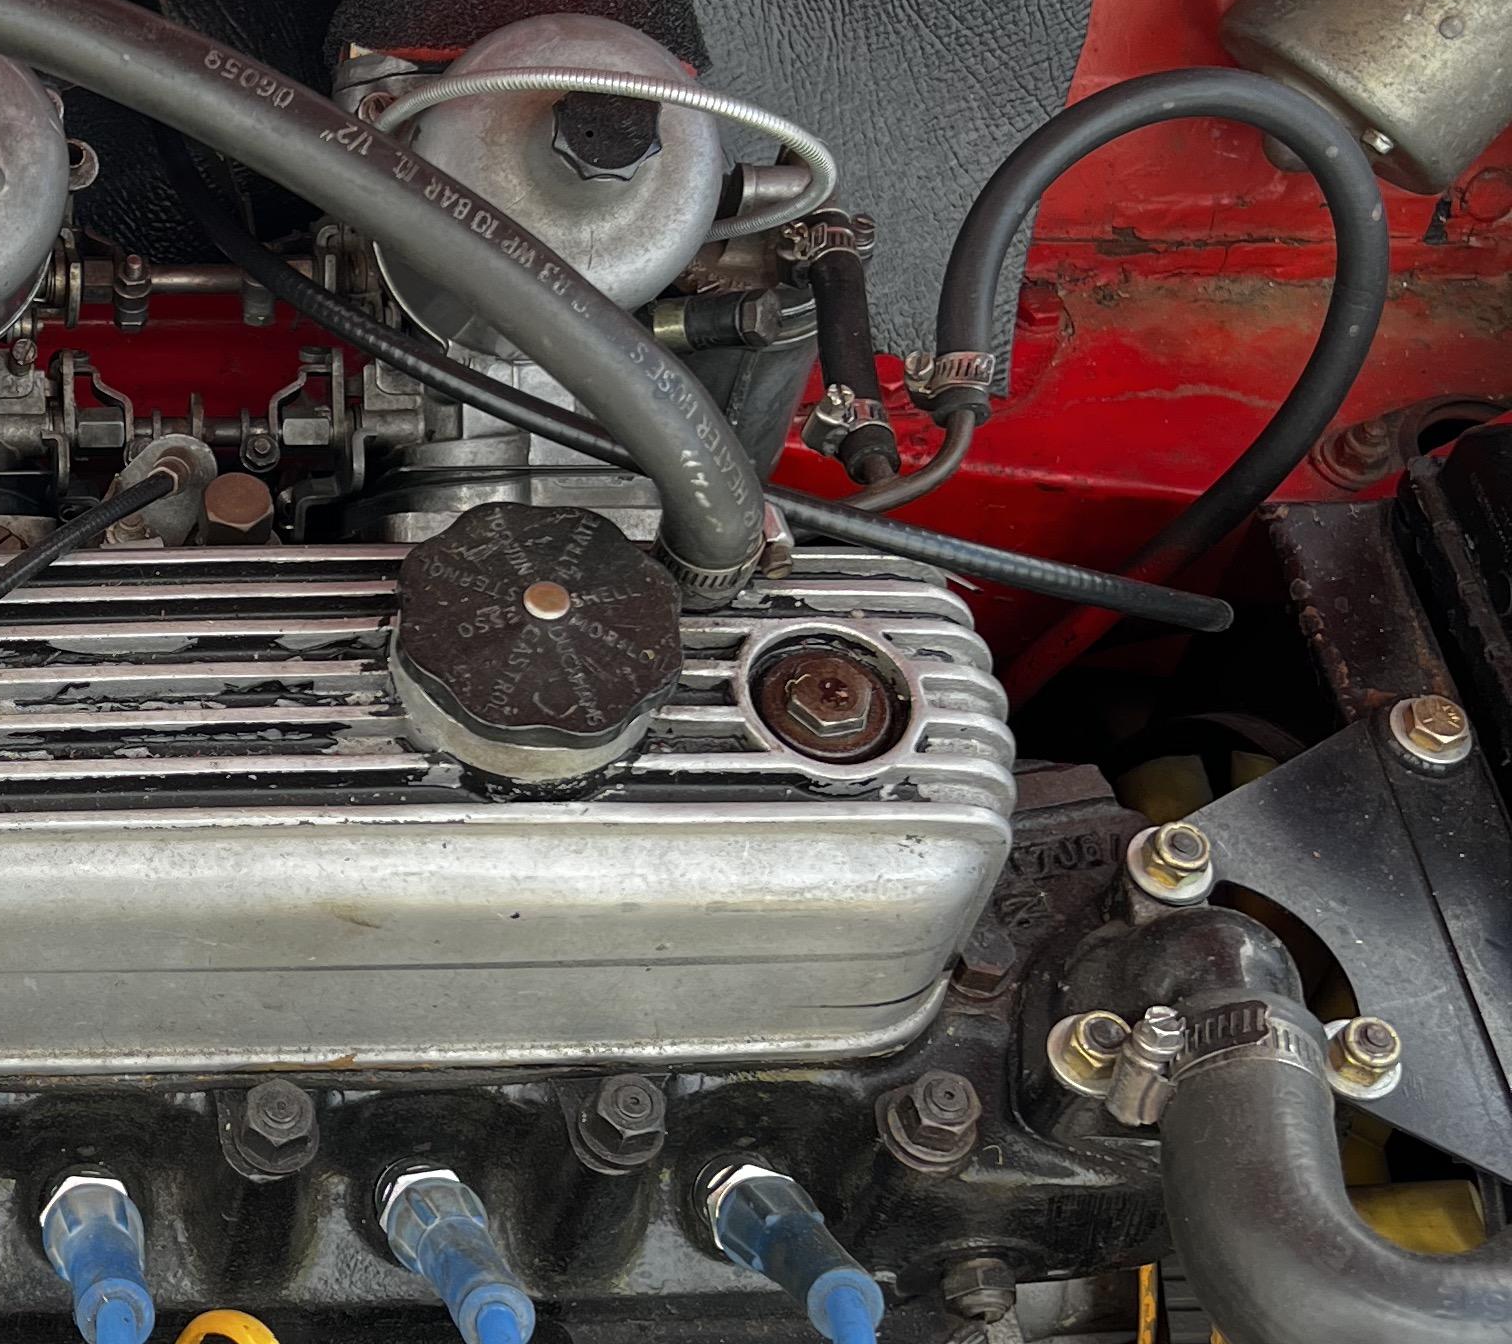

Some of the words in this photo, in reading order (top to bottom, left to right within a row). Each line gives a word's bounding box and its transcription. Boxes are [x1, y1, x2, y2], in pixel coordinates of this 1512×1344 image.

[422, 175, 473, 220] BAR
[646, 360, 699, 419] HOSE
[696, 416, 749, 505] HEATER
[569, 585, 643, 608] SHELL
[486, 622, 541, 714] CASTROL
